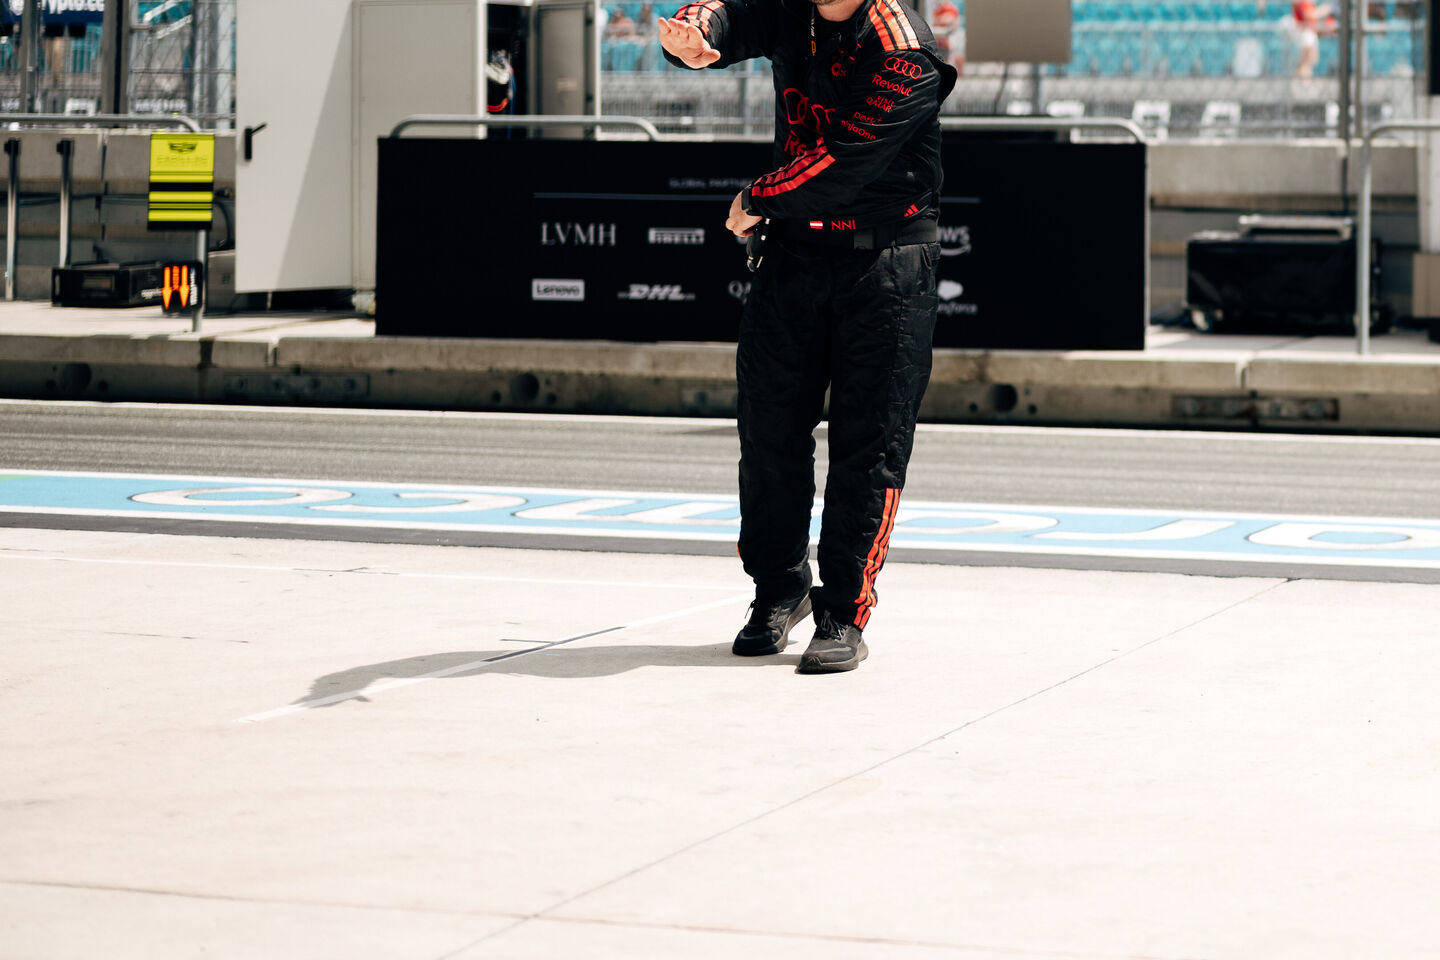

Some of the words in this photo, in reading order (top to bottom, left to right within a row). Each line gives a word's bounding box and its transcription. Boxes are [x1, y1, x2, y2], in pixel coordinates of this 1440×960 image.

[872, 74, 913, 97] Revolut
[866, 96, 892, 113] QATAR
[841, 119, 876, 141] ninjaOne
[831, 219, 857, 231] NNI
[541, 222, 617, 247] LVMH
[648, 227, 705, 245] PIRELLI
[536, 283, 580, 297] Lenovo
[628, 283, 686, 301] DHL
